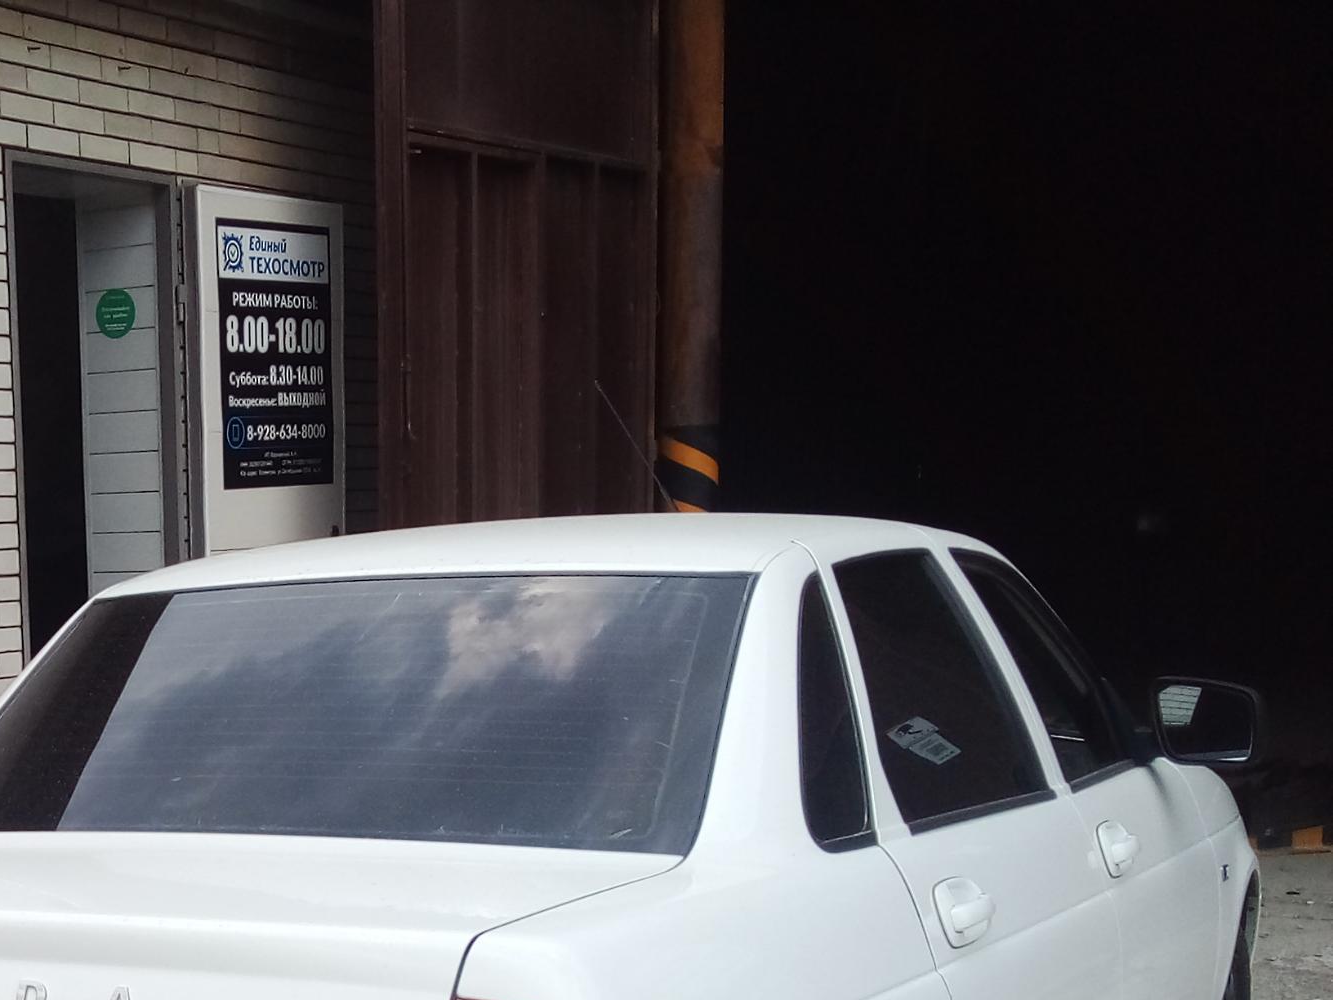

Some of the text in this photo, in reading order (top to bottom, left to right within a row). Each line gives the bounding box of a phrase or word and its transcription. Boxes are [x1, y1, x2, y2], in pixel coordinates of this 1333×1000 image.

[249, 235, 287, 253] Единый
[249, 256, 325, 278] ТЕХОСМОТР
[232, 291, 319, 310] РЕЖИМ РАБОТЫ:
[226, 314, 326, 354] 8.00-18.00
[229, 365, 324, 388] Суббота: 8.30-14.00
[277, 389, 326, 408] ВЫХОДНОЙ
[247, 423, 326, 441] 8-928-634-8000
